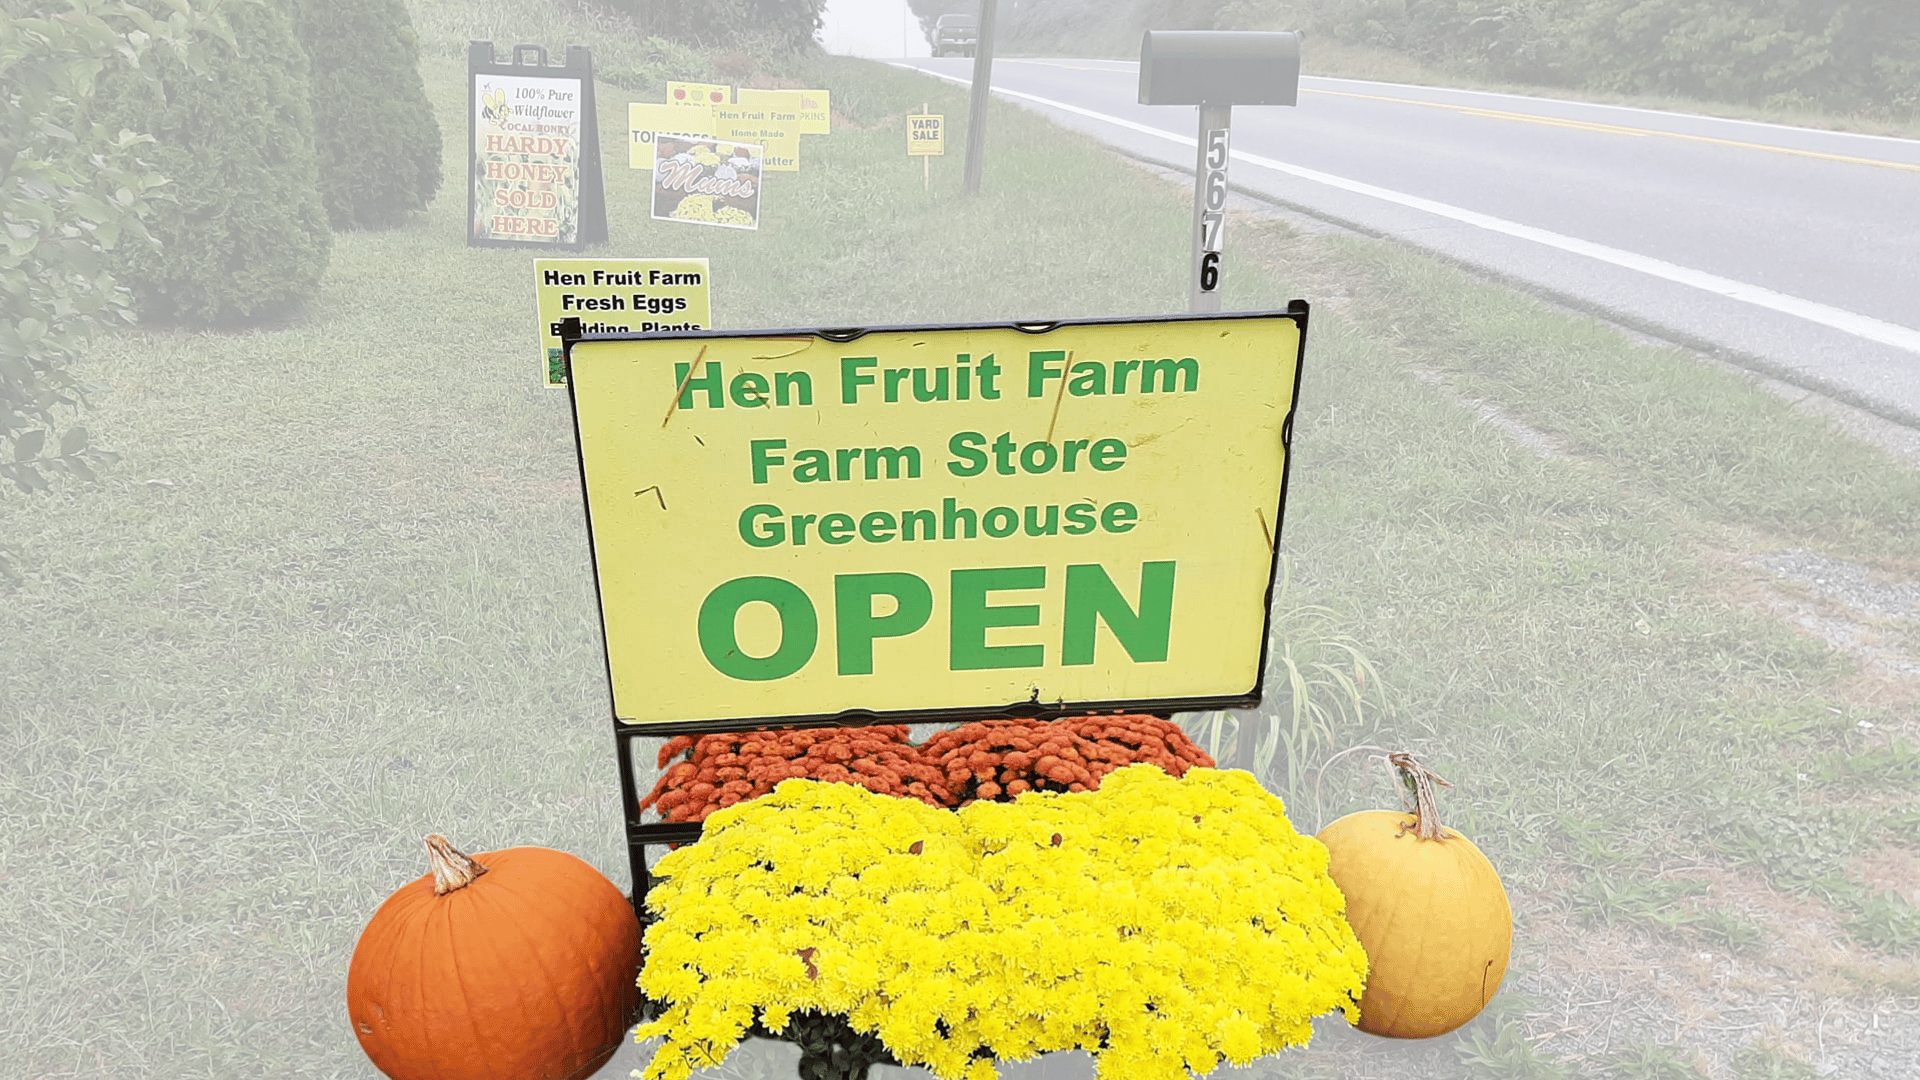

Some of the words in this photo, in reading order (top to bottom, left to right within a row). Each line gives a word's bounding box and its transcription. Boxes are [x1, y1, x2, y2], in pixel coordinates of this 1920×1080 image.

[515, 88, 545, 100] 100%
[548, 89, 573, 101] Pure
[514, 105, 574, 120] Wildflower
[719, 111, 739, 120] Hen
[742, 111, 765, 120] Fruit
[771, 112, 795, 121] Farm
[500, 119, 533, 132] LOCAL
[536, 124, 570, 134] HONEY
[912, 119, 940, 129] YARD
[731, 130, 757, 138] Home
[760, 130, 785, 138] Made
[912, 130, 939, 140] SALE
[486, 135, 569, 155] HARDY
[762, 156, 795, 166] utter
[486, 162, 569, 183] HONEY
[660, 161, 754, 197] Mums
[495, 189, 557, 209] SOLD
[492, 216, 559, 236] HERE
[544, 270, 585, 285] Hen
[593, 270, 642, 285] Fruit
[649, 270, 701, 285] Farm
[562, 294, 625, 310] Fresh
[633, 294, 687, 314] Eggs
[550, 322, 629, 336] Bdding
[674, 359, 813, 411] Hen
[841, 353, 1002, 404] Fruit
[1027, 350, 1200, 399] Farm
[750, 438, 921, 485] Farm
[947, 431, 1128, 476] Store
[738, 497, 1139, 548] Greenhouse
[697, 560, 1177, 681] OPEN
